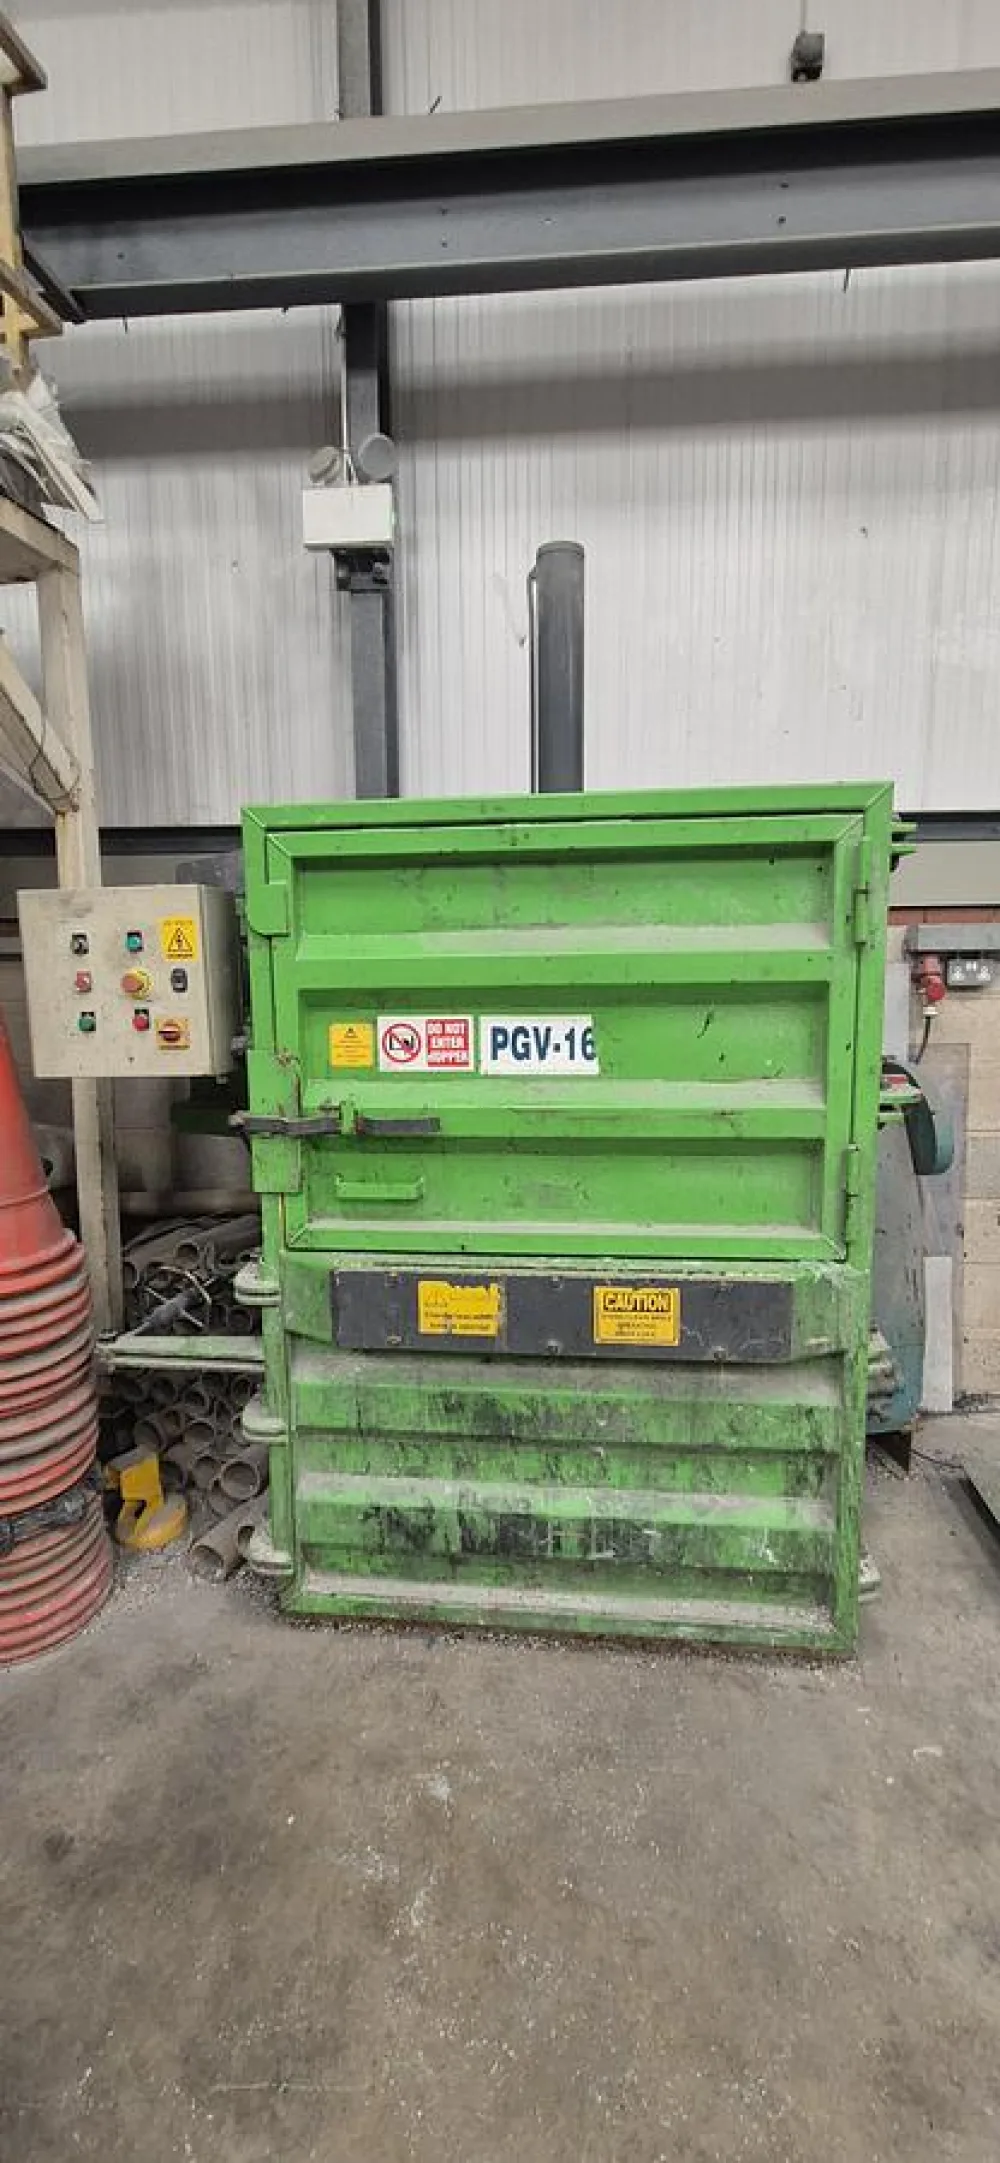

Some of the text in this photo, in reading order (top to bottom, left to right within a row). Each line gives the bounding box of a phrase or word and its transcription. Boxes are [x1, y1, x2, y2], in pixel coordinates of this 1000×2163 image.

[428, 1023, 464, 1034] DO NOT
[432, 1036, 464, 1048] ENTER
[491, 1025, 596, 1061] PGV-16
[603, 1293, 671, 1311] CAUTION
